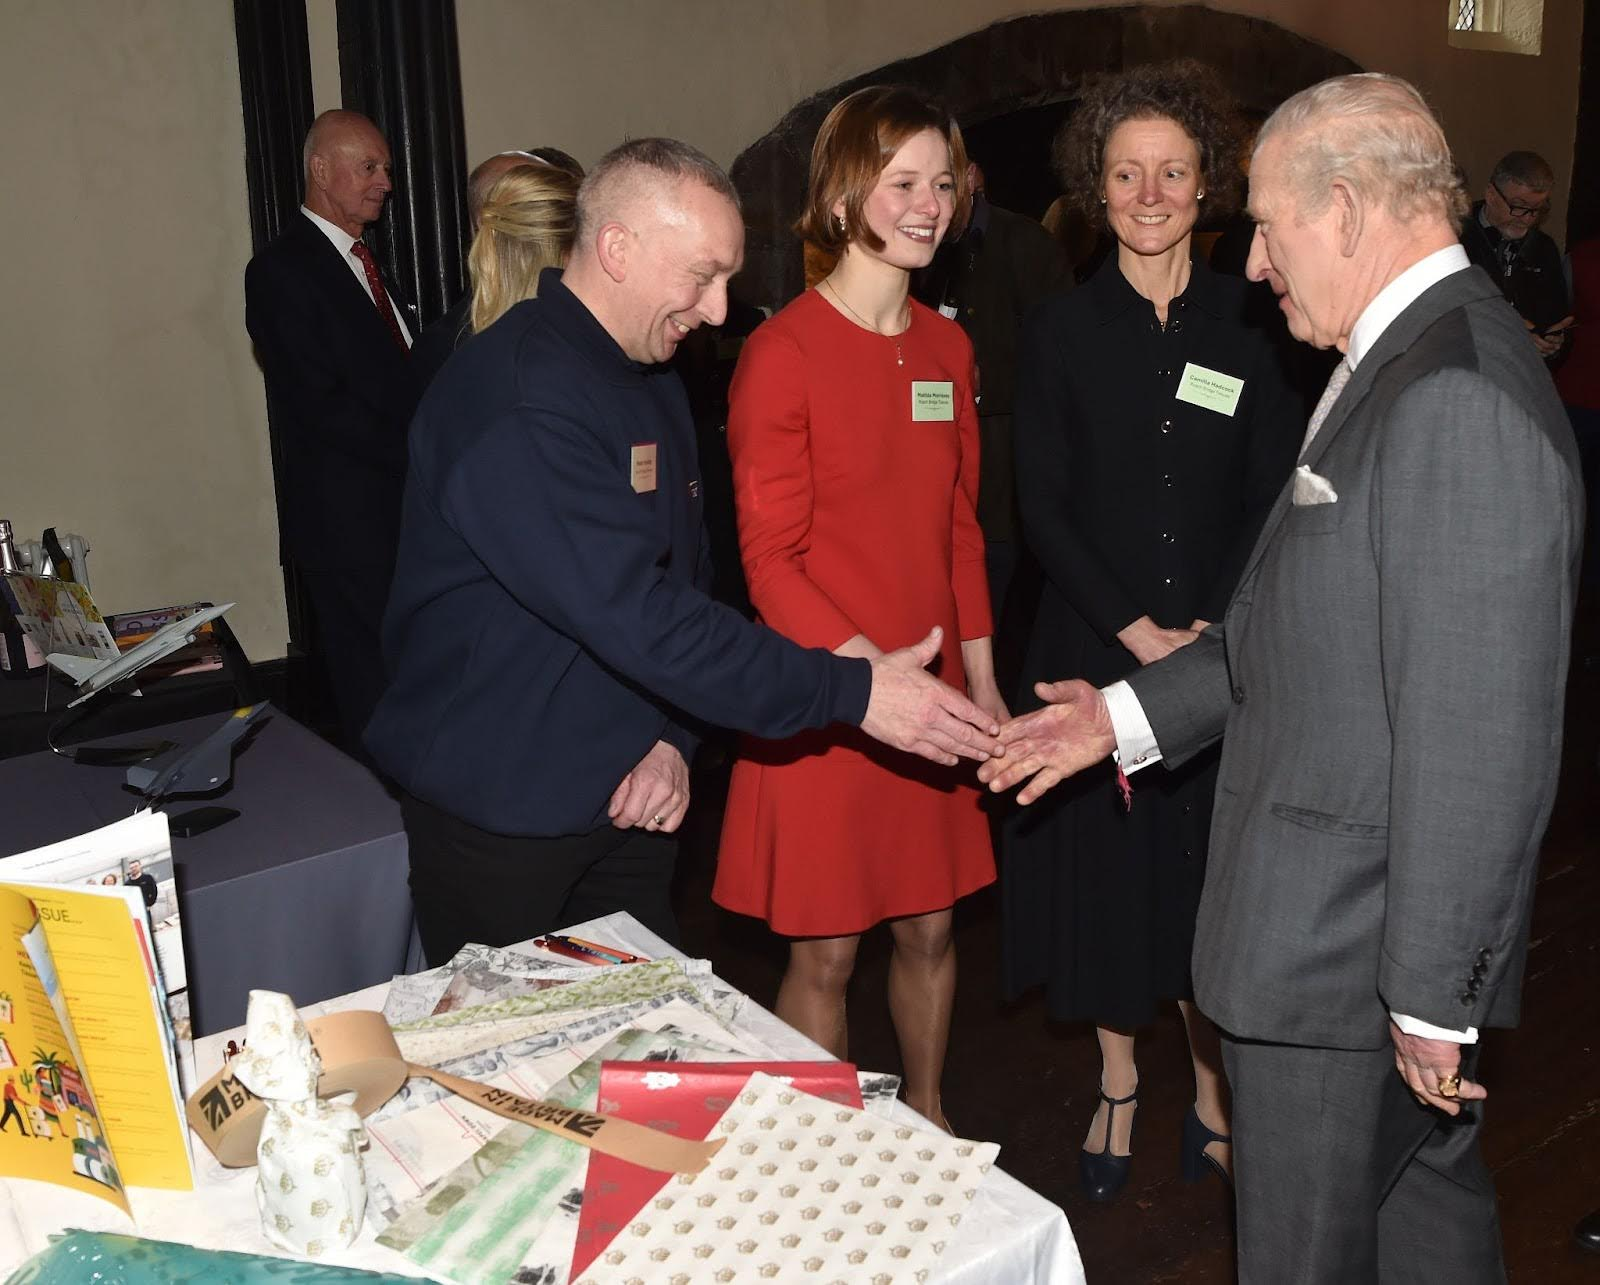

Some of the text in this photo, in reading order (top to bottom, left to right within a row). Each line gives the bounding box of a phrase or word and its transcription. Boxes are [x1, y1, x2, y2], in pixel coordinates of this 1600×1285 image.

[1189, 374, 1210, 385] Camilla
[481, 1093, 564, 1125] MADE IN
[491, 1088, 572, 1116] BRITAIN
